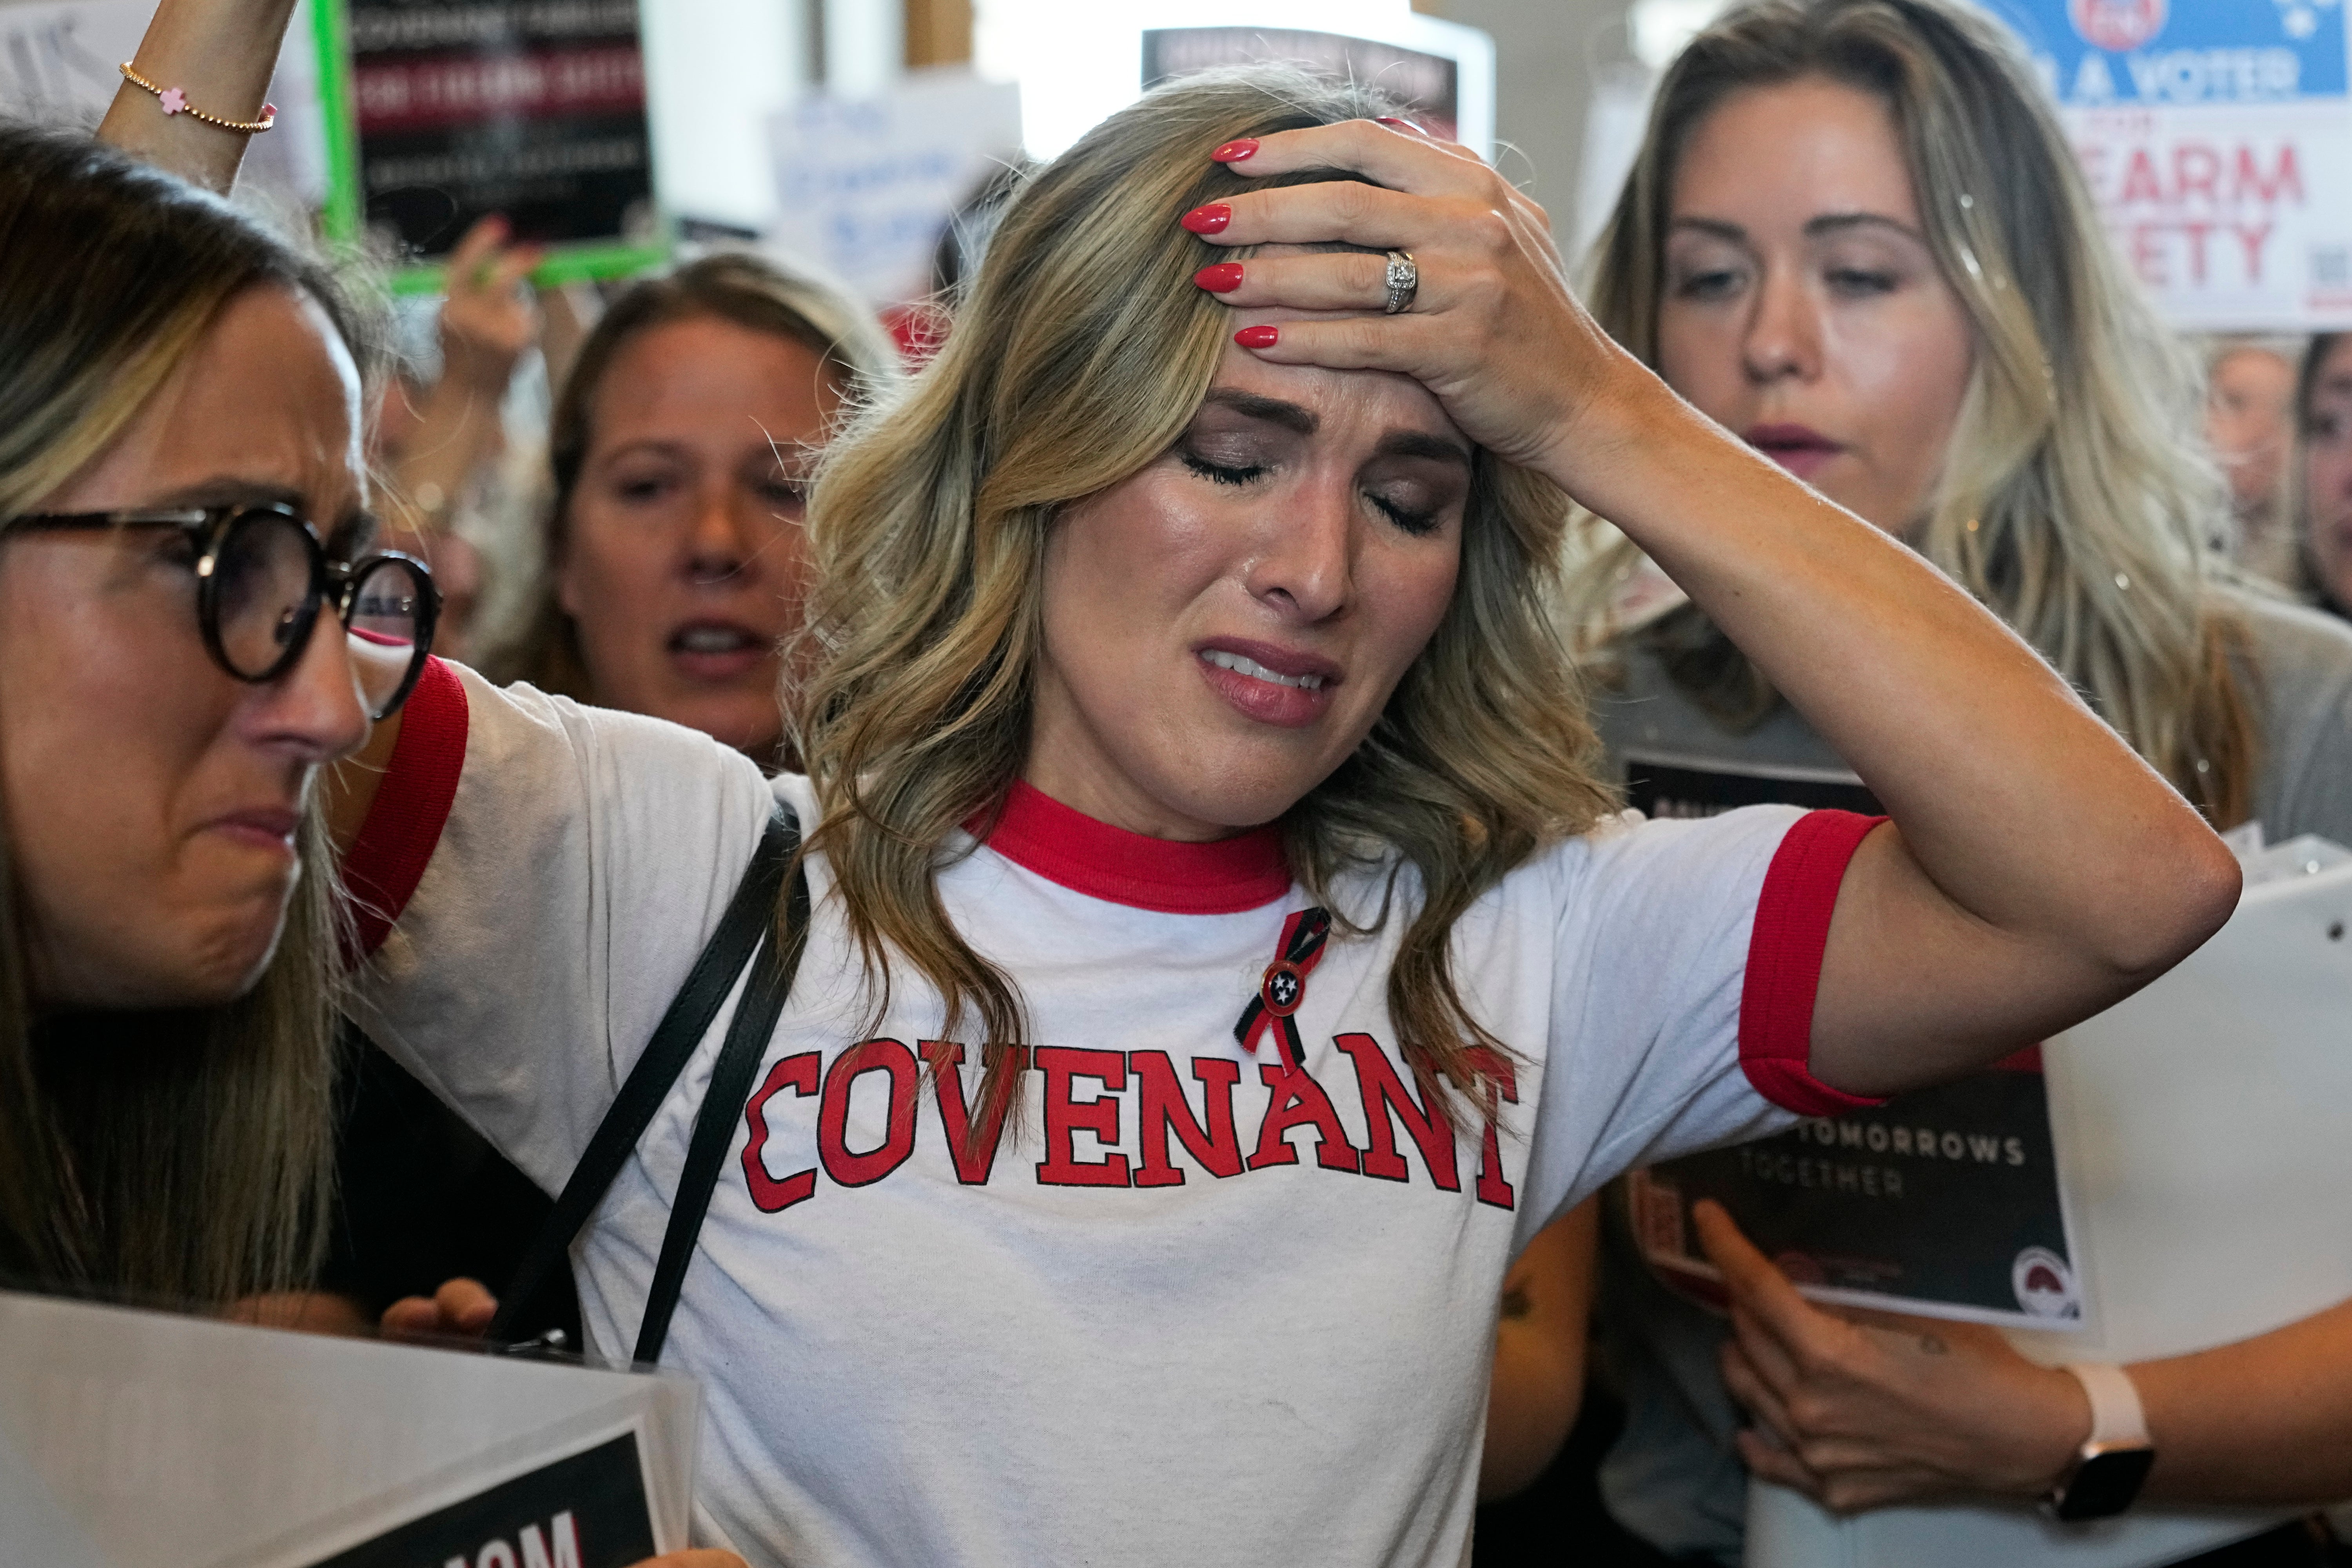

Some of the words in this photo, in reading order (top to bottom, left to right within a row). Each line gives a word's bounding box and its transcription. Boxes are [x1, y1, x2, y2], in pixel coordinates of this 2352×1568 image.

[2129, 49, 2300, 101] VOTER
[742, 1032, 1522, 1213] COVENANT
[1798, 1116, 2026, 1167] TOMORROWS
[1740, 1148, 1904, 1199] TOGETHER
